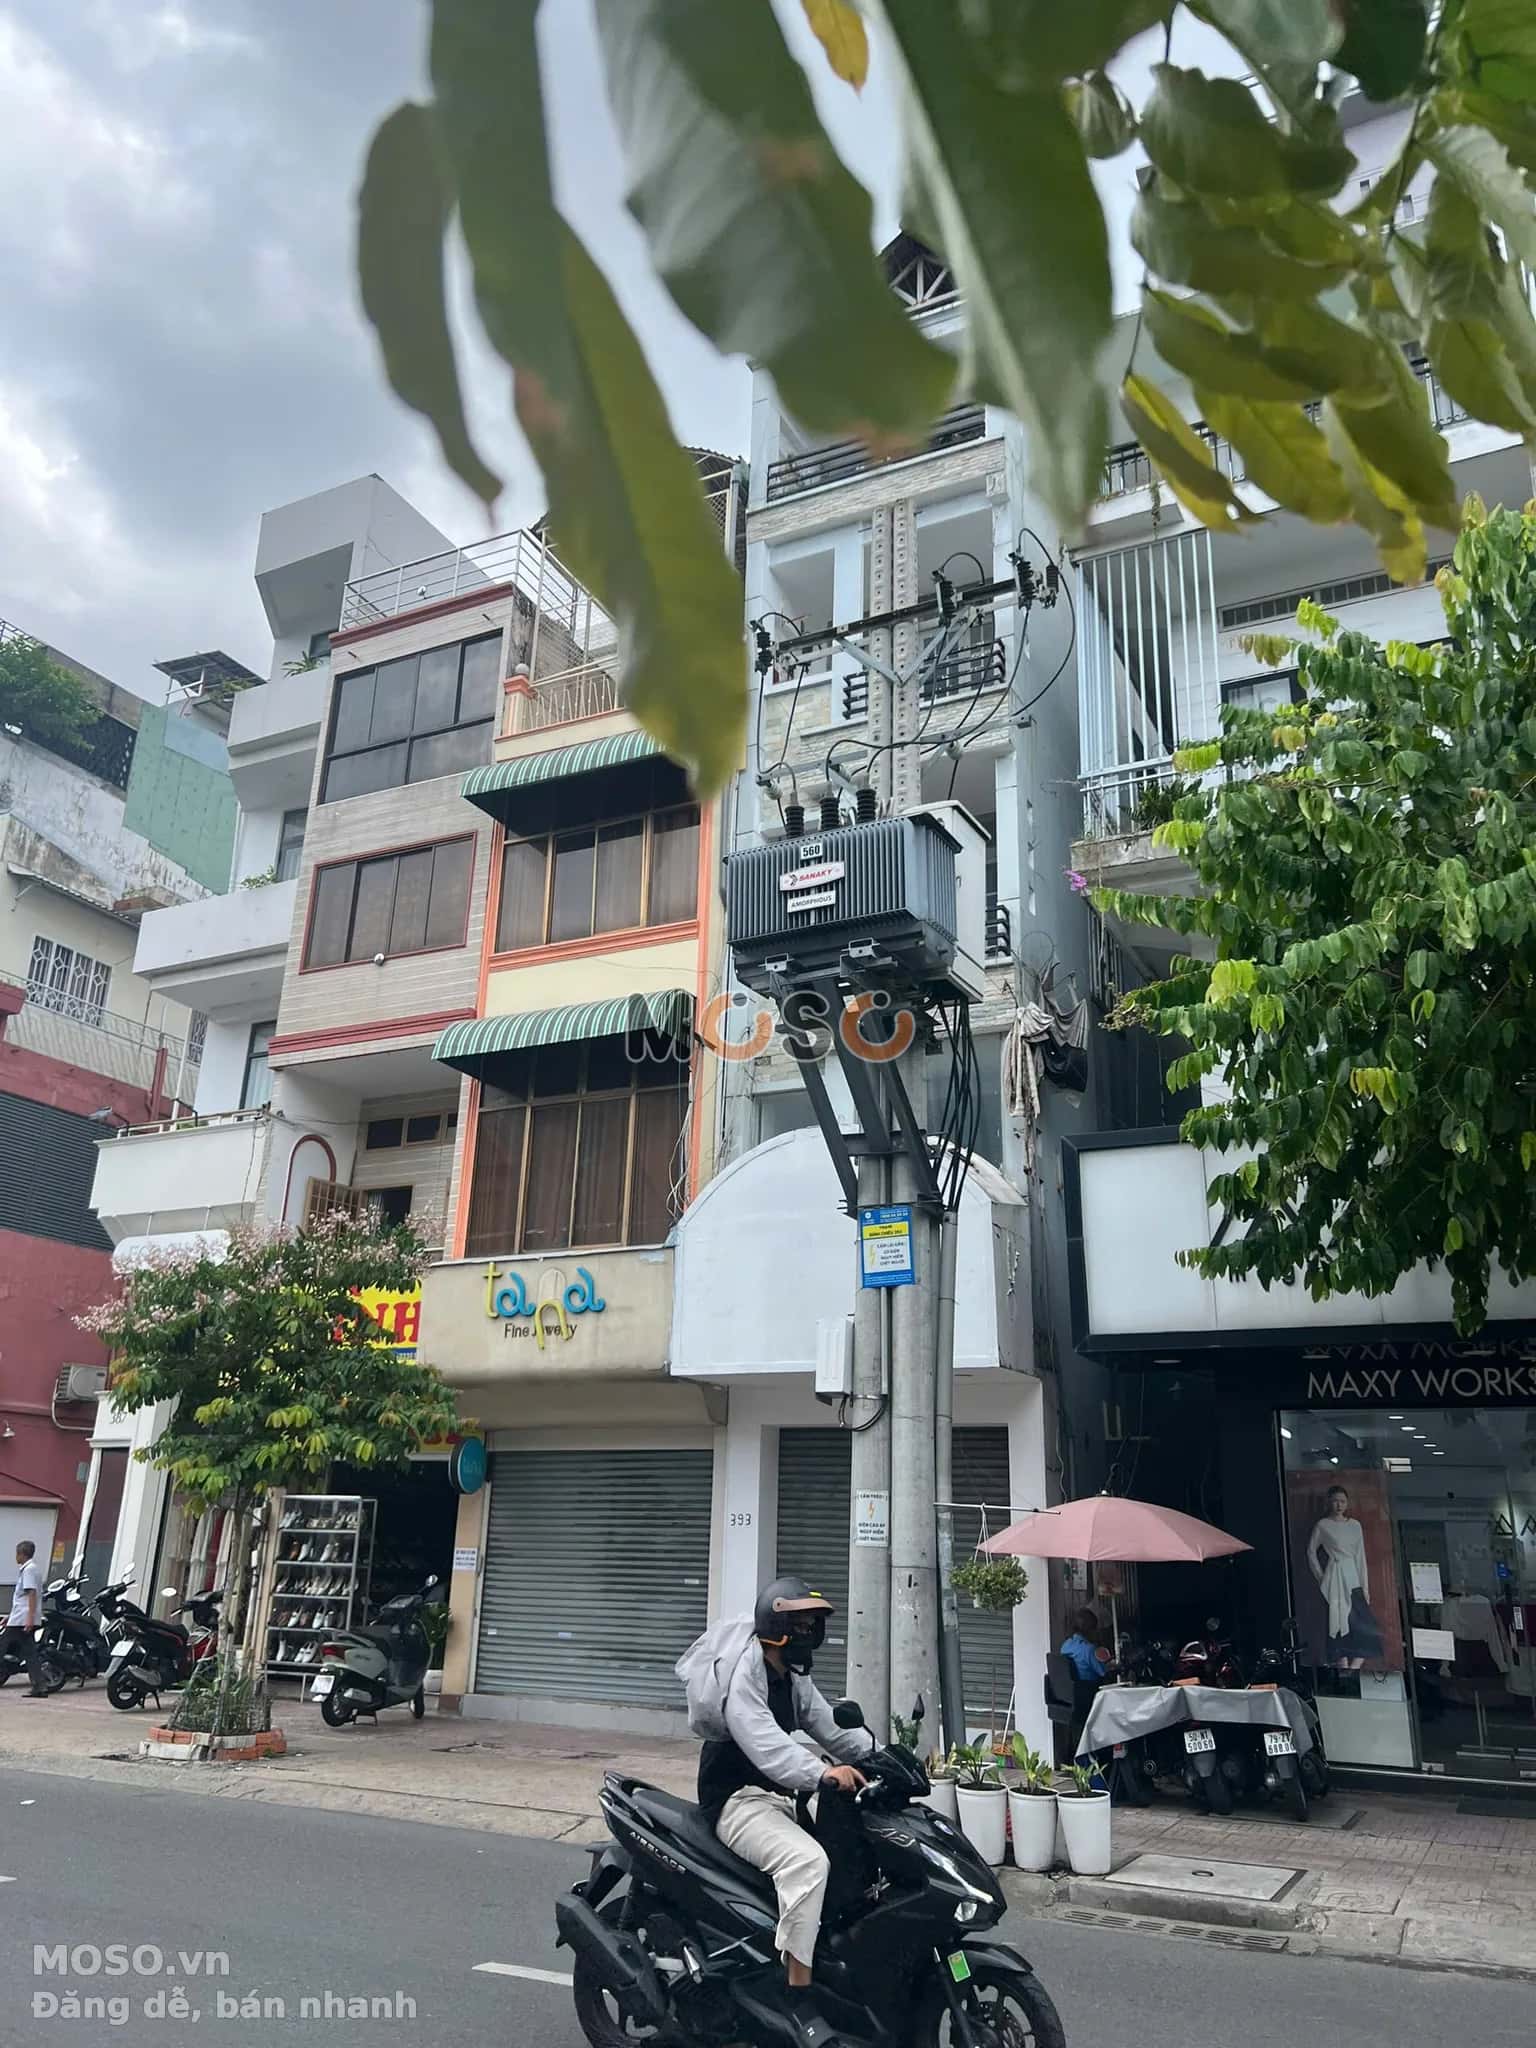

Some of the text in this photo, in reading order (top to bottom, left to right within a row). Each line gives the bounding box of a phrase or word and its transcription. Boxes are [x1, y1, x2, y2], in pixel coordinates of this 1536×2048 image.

[802, 844, 821, 857] 560
[503, 1322, 530, 1339] Fine
[1307, 1369, 1401, 1399] MAXY
[730, 1513, 751, 1527] 393
